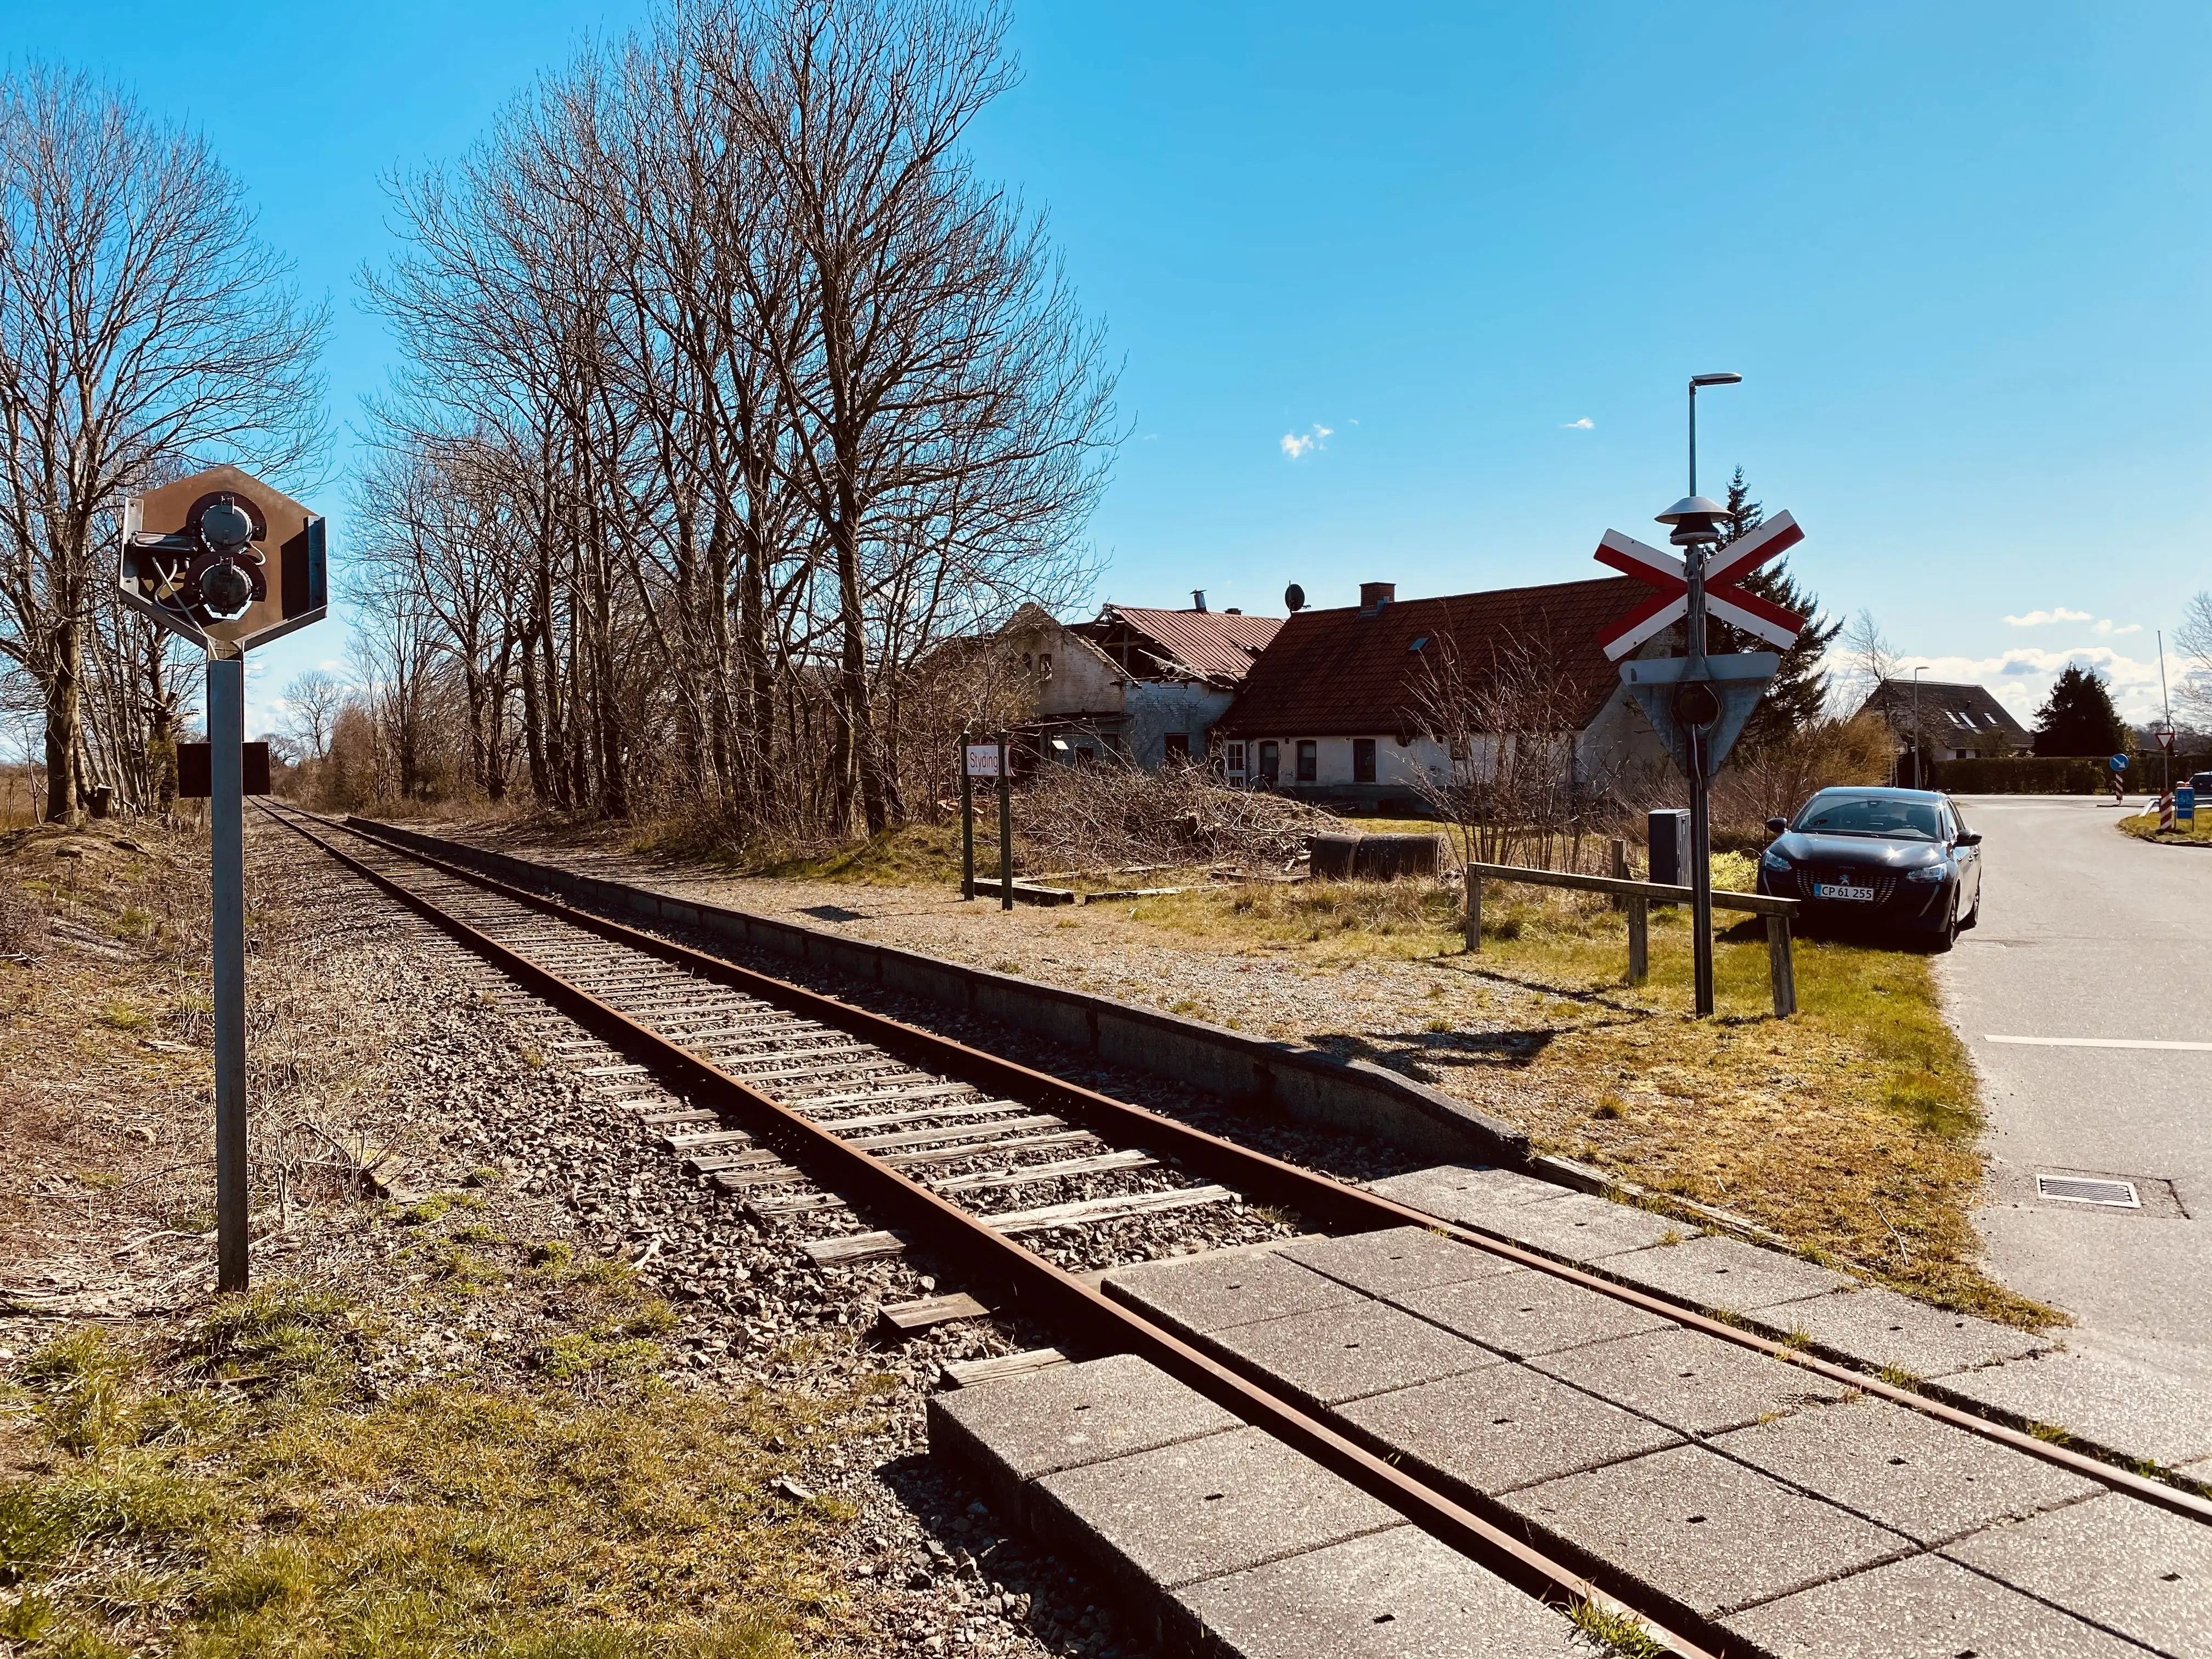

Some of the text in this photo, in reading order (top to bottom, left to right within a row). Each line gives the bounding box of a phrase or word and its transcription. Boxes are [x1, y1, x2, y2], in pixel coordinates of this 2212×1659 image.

[970, 752, 998, 772] Styding
[1822, 887, 1835, 895] CP
[1838, 888, 1849, 897] 61
[1853, 889, 1872, 899] 255
